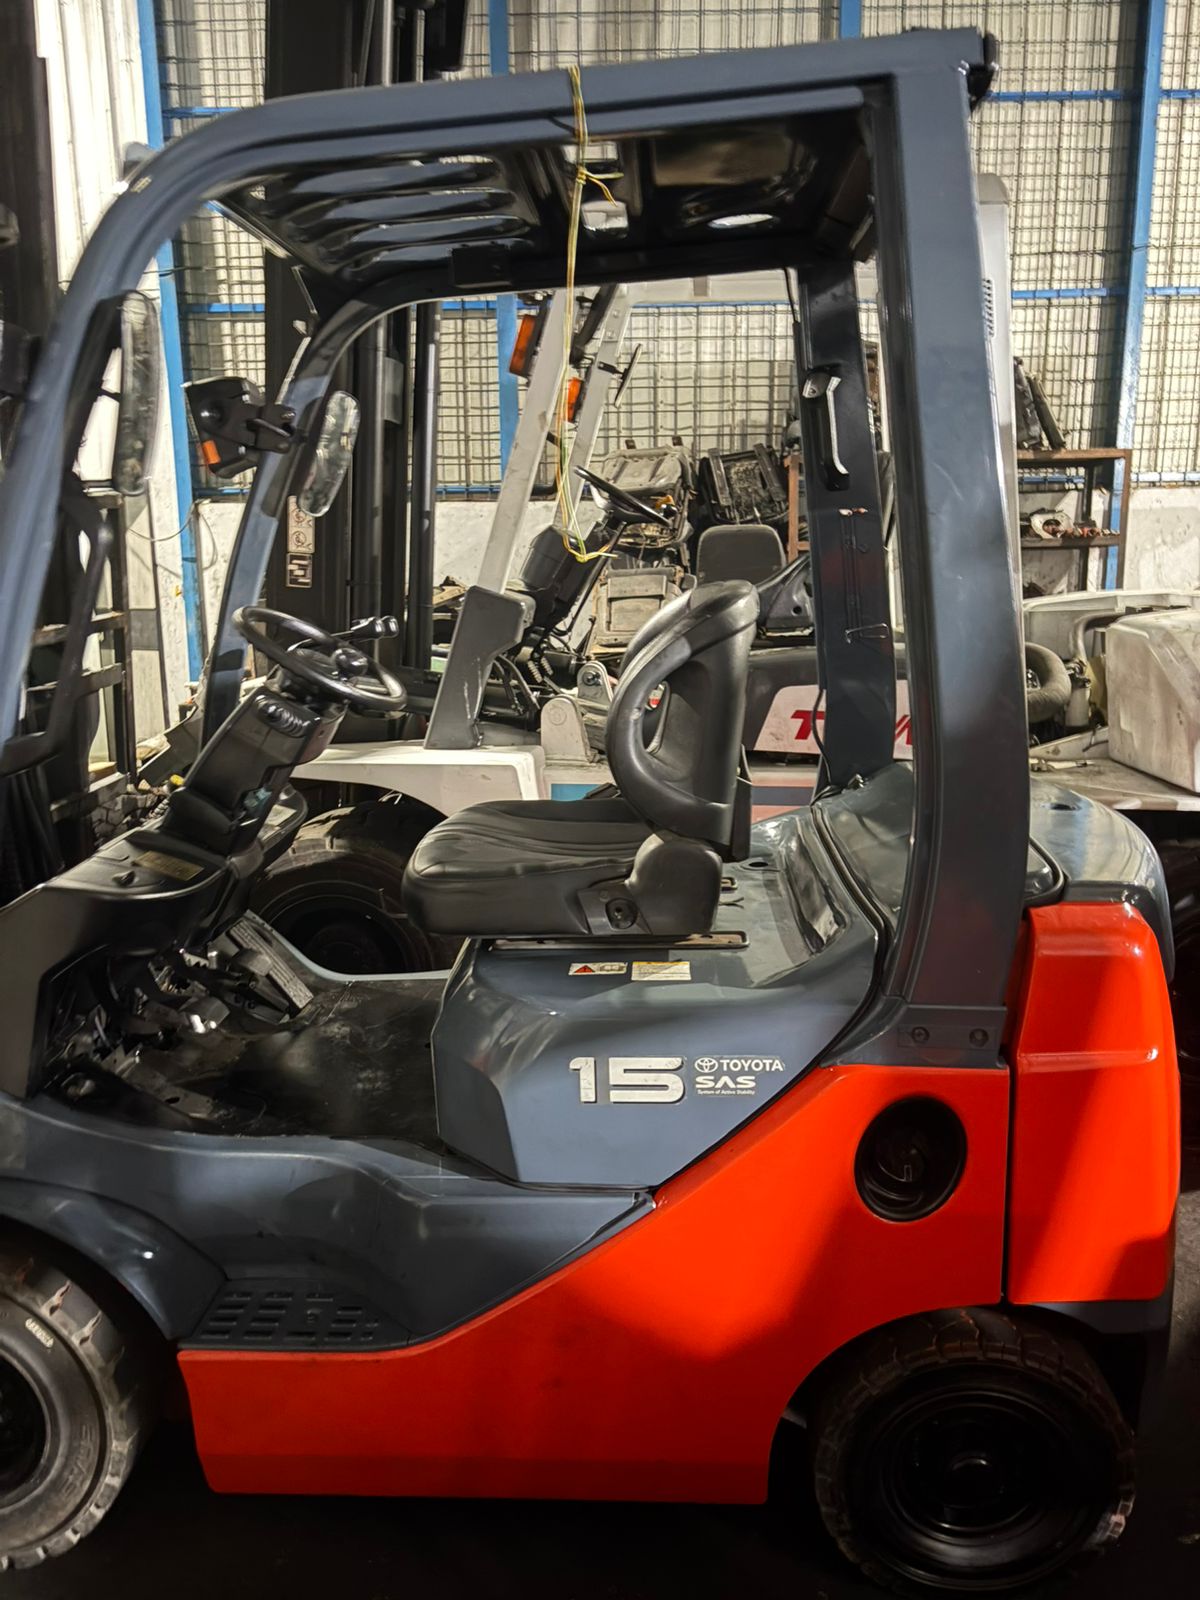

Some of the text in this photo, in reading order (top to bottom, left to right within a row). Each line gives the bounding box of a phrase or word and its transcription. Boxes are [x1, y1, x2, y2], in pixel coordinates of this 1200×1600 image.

[719, 1059, 784, 1072] TOYOTA
[569, 1057, 685, 1103] 15
[695, 1075, 757, 1089] SAS
